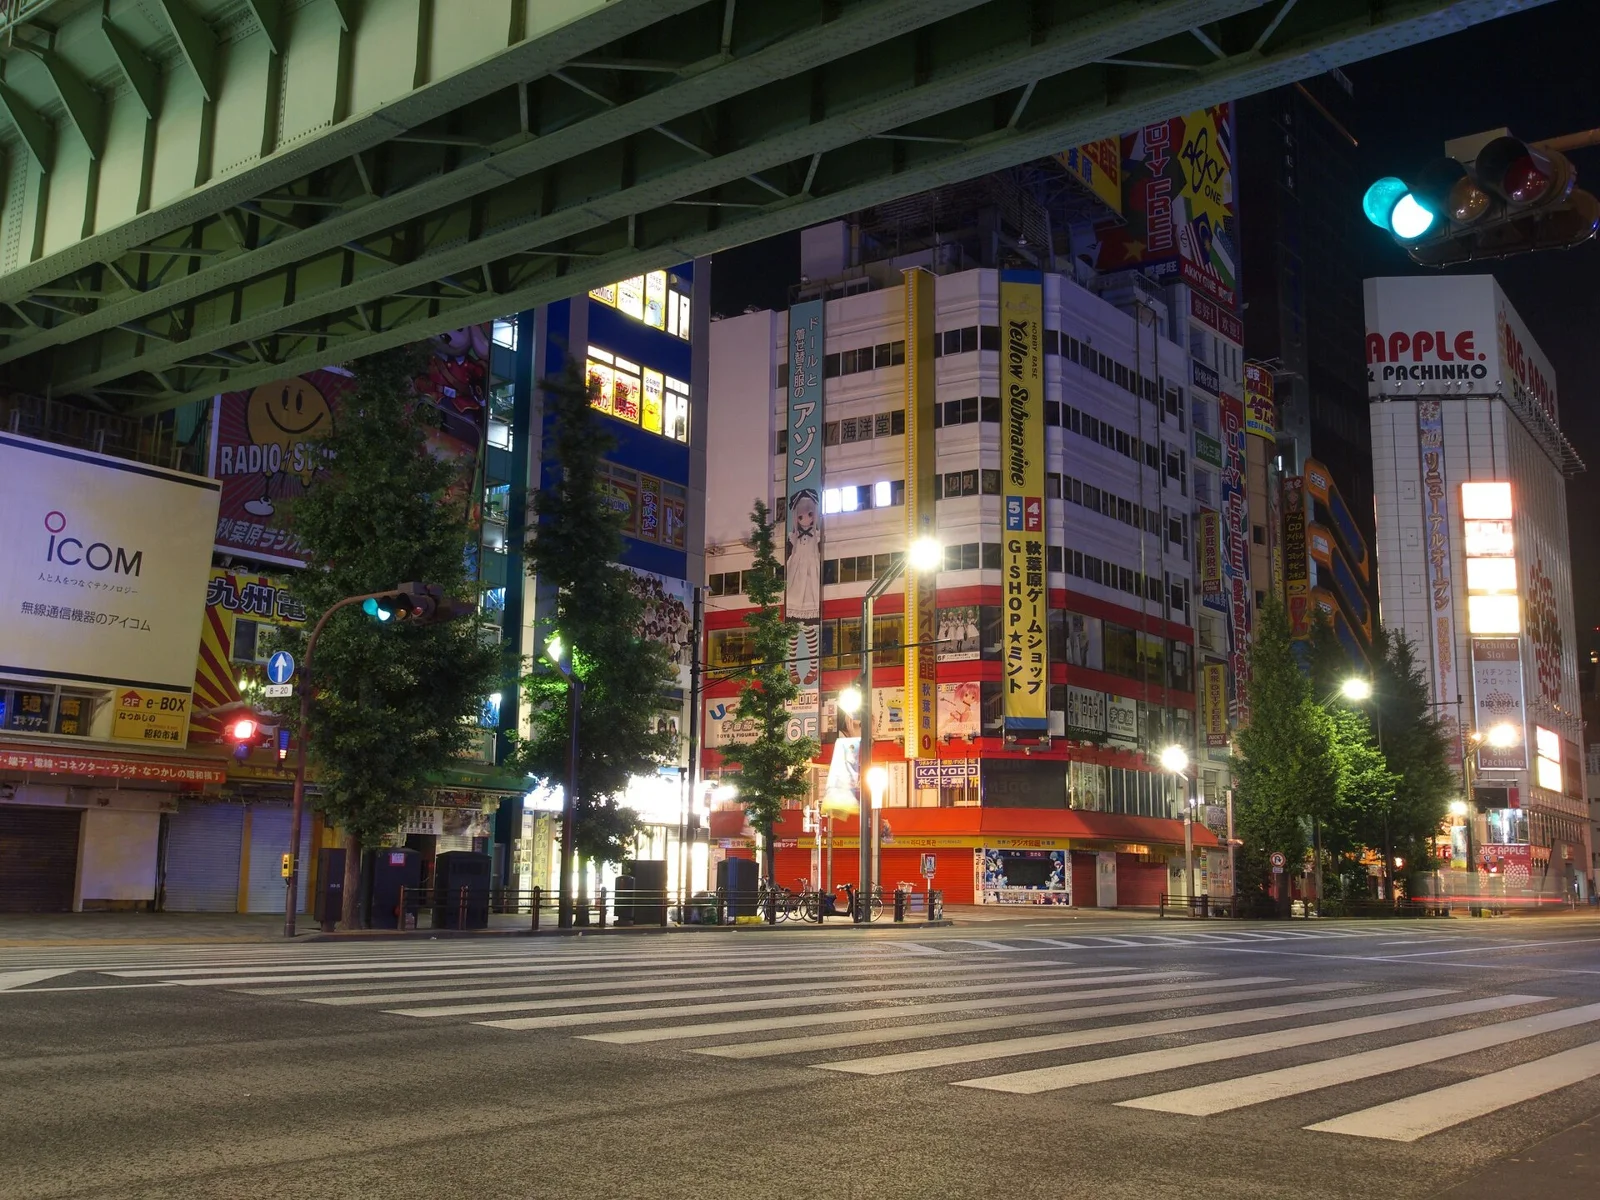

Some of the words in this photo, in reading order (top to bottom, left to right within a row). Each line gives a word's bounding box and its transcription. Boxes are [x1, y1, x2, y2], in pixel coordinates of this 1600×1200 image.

[1204, 185, 1222, 206] ONE
[806, 316, 820, 388] ドールと
[1008, 319, 1029, 381] Yellow
[793, 327, 807, 399] 着せ替え服の
[1383, 363, 1488, 381] PACHINKO
[843, 415, 890, 440] 海洋堂
[1008, 383, 1031, 488] Submarine
[793, 401, 818, 483] アゾン
[1225, 411, 1241, 489] DUTY
[220, 442, 281, 475] RADIO
[1008, 501, 1021, 527] 5F
[1027, 501, 1040, 527] 4F
[1286, 514, 1304, 522] ゲーム
[1229, 490, 1244, 573] FREE
[1288, 523, 1302, 532] CD
[1424, 452, 1450, 612] リニューアルオープン
[1287, 542, 1305, 550] アニメ
[37, 571, 139, 595] 人と人をつなぐテクノロジー
[20, 600, 152, 632] 無線通信機器のアイコム
[1025, 540, 1043, 695] 秋葉原ゲームショップ
[1475, 641, 1517, 650] Pachinko
[1487, 651, 1506, 659] Slot
[123, 698, 140, 708] 2F
[146, 697, 187, 712] e-BOX
[922, 683, 931, 729] 秋葉原
[118, 712, 156, 723] なつかしの
[787, 717, 817, 742] 6F
[143, 729, 179, 742] 昭和市場
[1482, 758, 1525, 767] Pachinko
[1011, 838, 1041, 847] ラジオ会館
